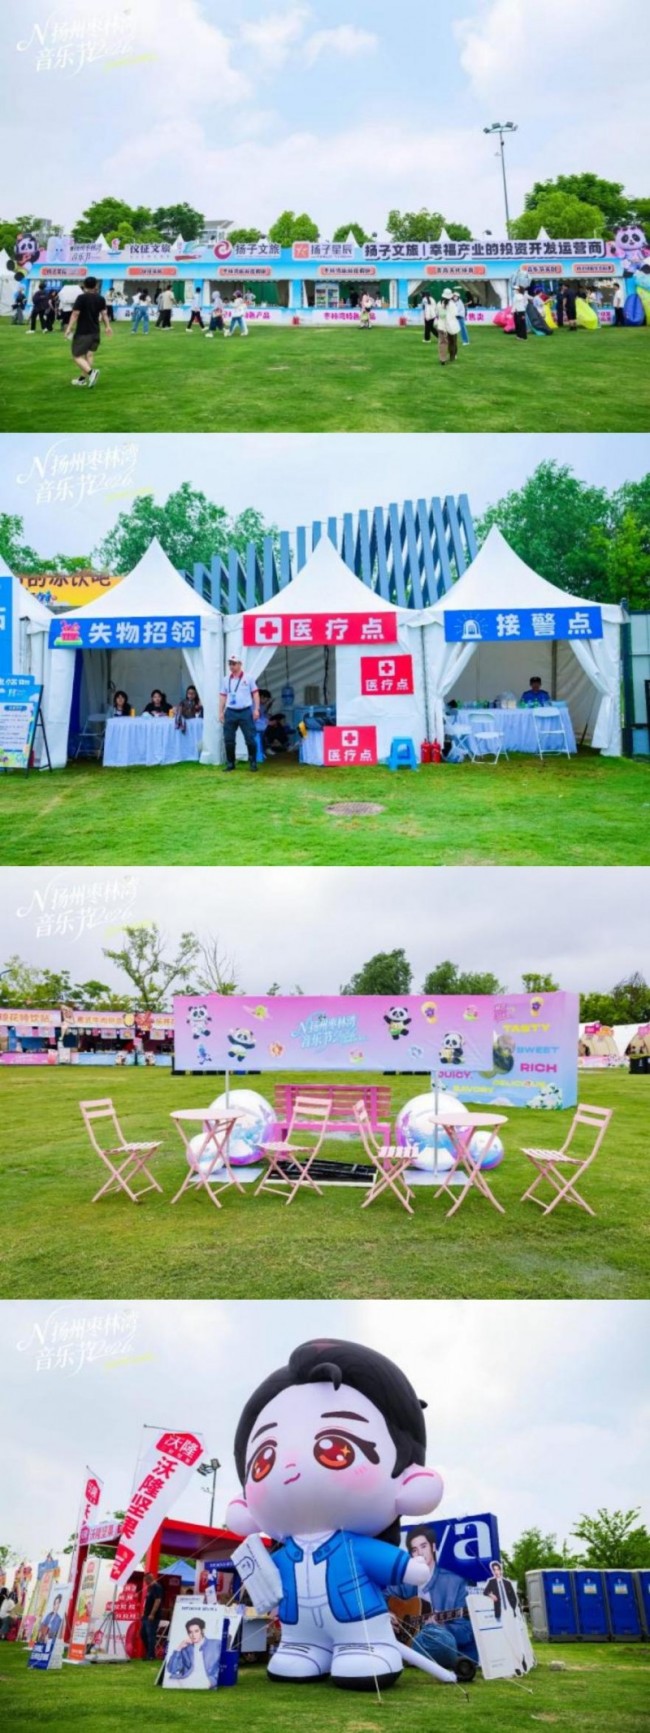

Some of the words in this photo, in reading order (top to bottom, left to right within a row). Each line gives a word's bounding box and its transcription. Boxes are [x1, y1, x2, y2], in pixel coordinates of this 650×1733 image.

[130, 244, 171, 254] 仪征文旅
[236, 244, 280, 255] 扬子文旅
[311, 244, 352, 255] 扬子星辰
[289, 617, 385, 641] 医疗点
[496, 612, 592, 637] 接警点
[88, 620, 196, 645] 失物招领
[365, 678, 409, 692] 医疗点
[327, 748, 372, 762] 医疗点
[503, 1023, 551, 1033] TASTY
[516, 1046, 560, 1054] SWEET
[520, 1063, 558, 1073] RICH
[164, 1434, 199, 1458] 沃隆
[120, 1456, 178, 1540] 沃隆坚果
